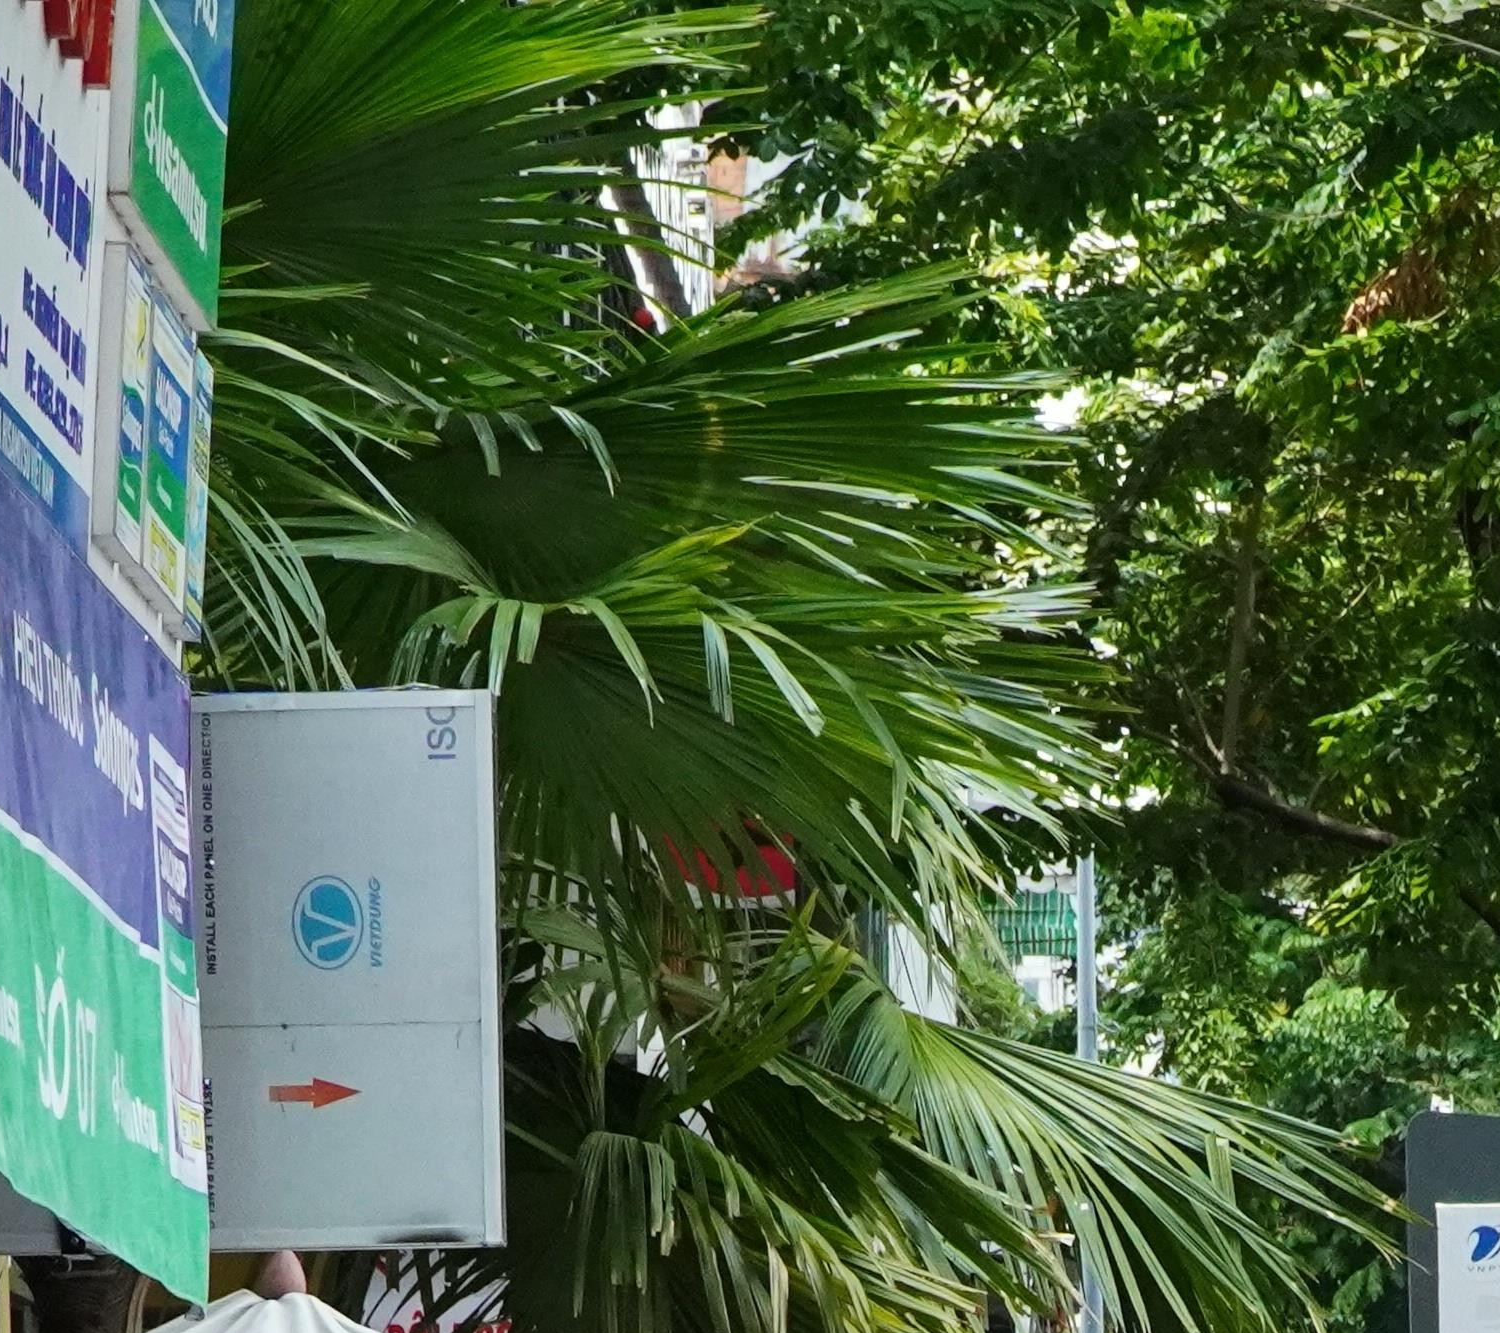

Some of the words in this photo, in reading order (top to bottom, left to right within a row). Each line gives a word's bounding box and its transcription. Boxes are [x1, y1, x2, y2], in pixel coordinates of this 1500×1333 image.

[143, 74, 208, 256] Hisamitsu
[203, 785, 213, 809] ONE
[204, 814, 213, 833] ON
[205, 883, 215, 918] EACH
[370, 876, 382, 968] VIETDUNG
[206, 922, 217, 975] INSTALL
